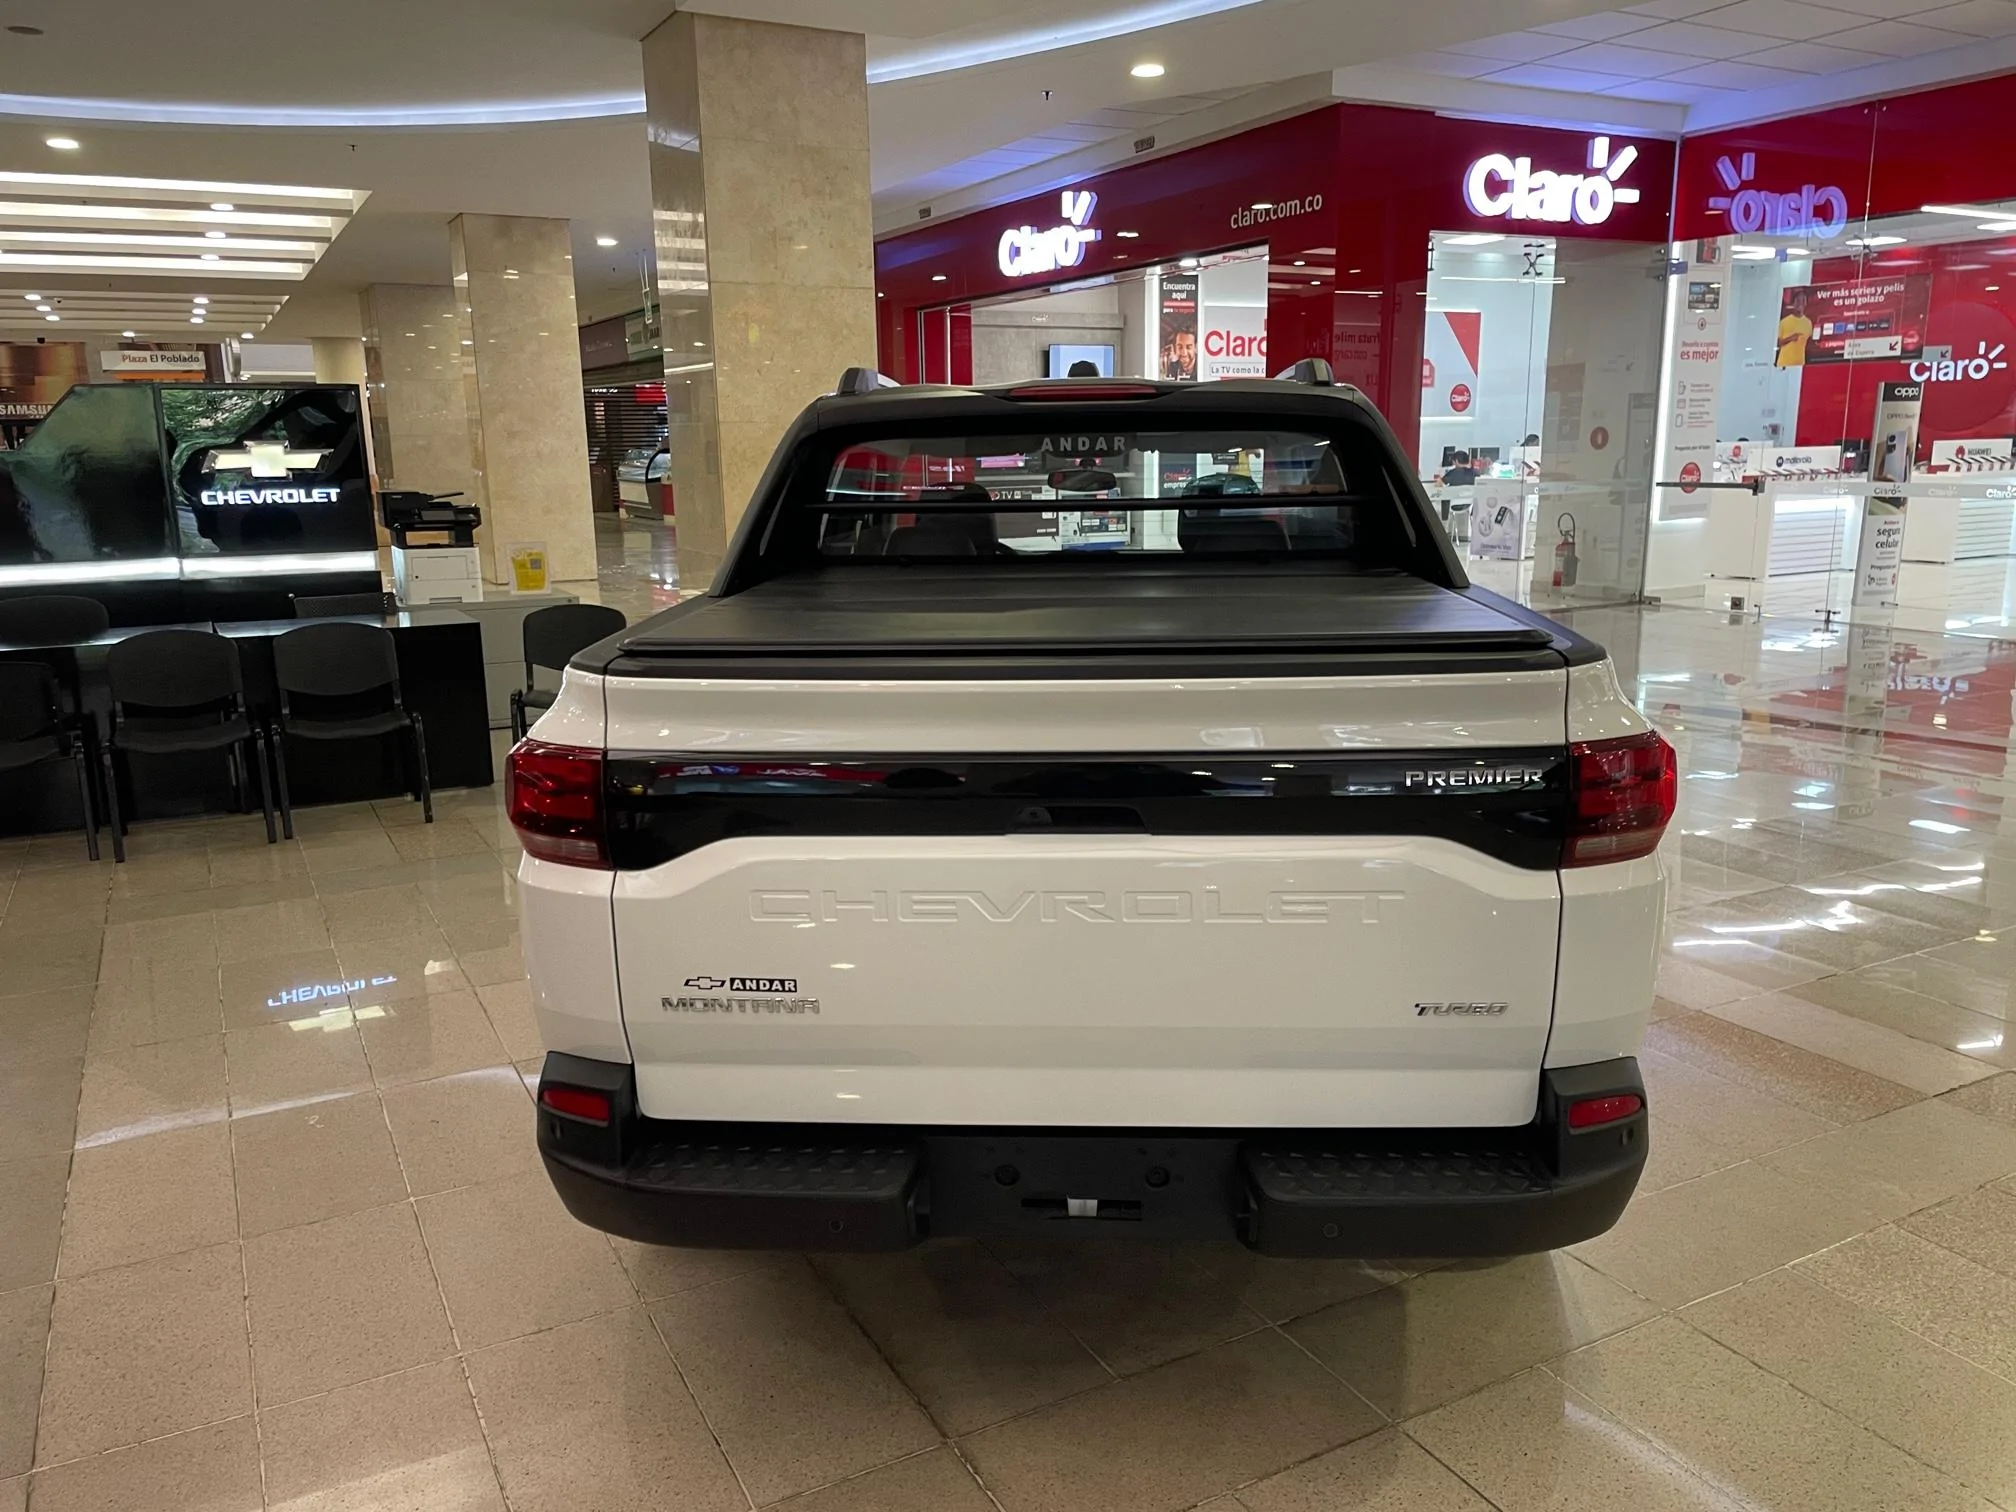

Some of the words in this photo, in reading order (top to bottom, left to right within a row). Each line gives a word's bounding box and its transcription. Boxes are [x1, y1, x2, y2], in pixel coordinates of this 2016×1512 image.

[1463, 153, 1614, 225] Claro
[1230, 194, 1323, 229] claro.com.co
[1163, 281, 1195, 291] Encuentra
[1817, 290, 1831, 299] Ver
[1832, 287, 1849, 298] más
[1850, 286, 1876, 297] series
[1877, 287, 1882, 296] y
[1883, 283, 1905, 295] pelis
[1834, 298, 1843, 306] es
[1844, 297, 1856, 305] un
[1857, 295, 1885, 306] golazo
[122, 354, 148, 363] Plaza
[150, 354, 158, 363] El
[160, 354, 200, 363] Poblado
[1680, 350, 1690, 360] es
[1692, 348, 1719, 362] mejor
[1211, 366, 1219, 374] La
[1221, 366, 1231, 374] TV
[1253, 366, 1260, 374] la
[1909, 358, 1989, 383] Claro
[1041, 436, 1126, 451] ANDAR
[200, 488, 341, 506] CHEVROLET
[1405, 769, 1543, 787] PREMIER
[749, 889, 1407, 924] CHEVROLET
[731, 979, 797, 991] ANDAR
[661, 997, 821, 1014] MONTANA
[1414, 1002, 1509, 1017] TURBO
